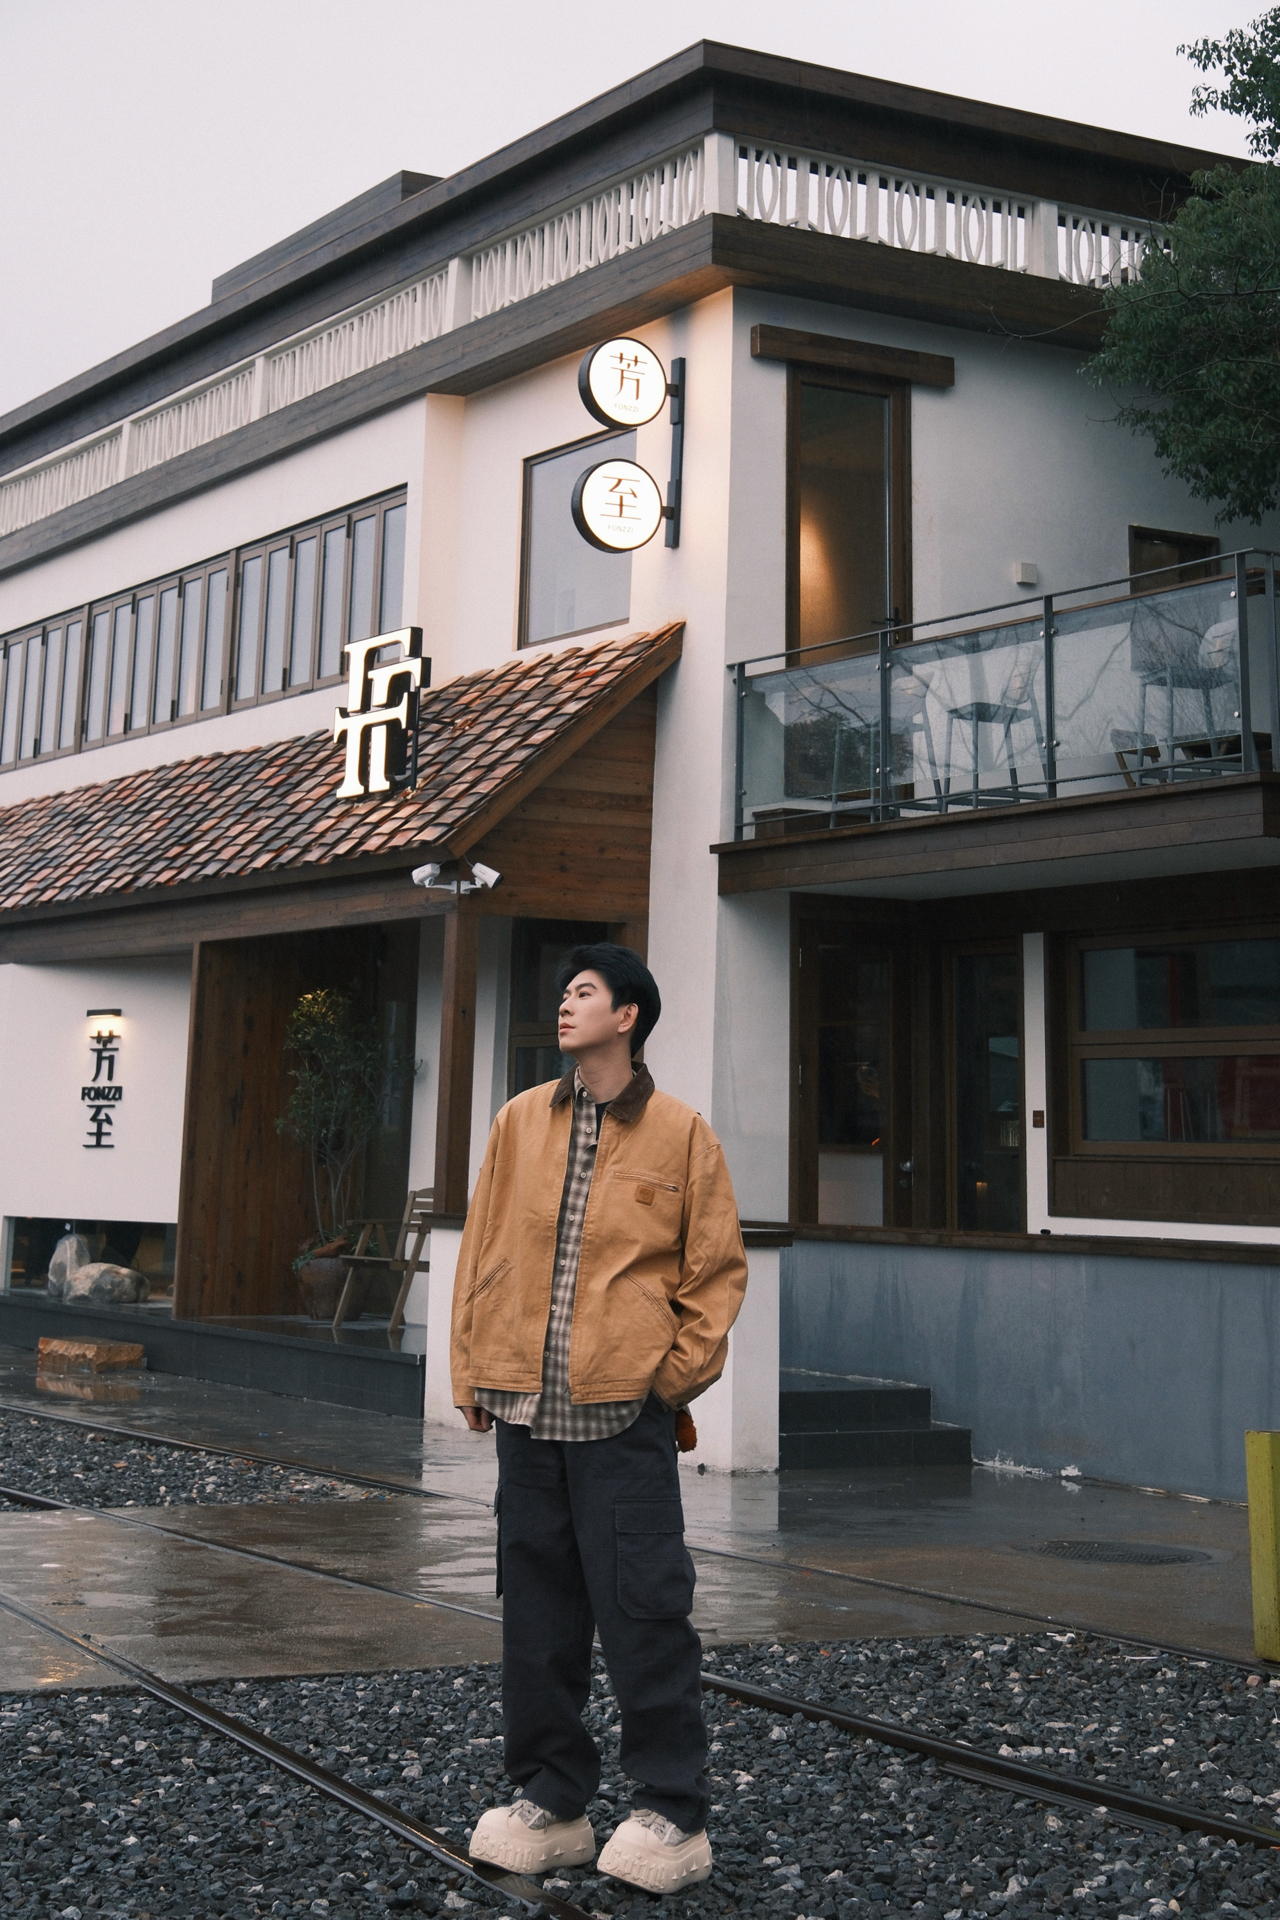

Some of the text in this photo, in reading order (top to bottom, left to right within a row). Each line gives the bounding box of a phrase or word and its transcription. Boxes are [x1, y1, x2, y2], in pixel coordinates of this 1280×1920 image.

[609, 352, 648, 401] 芳
[614, 402, 640, 413] FONZZI
[600, 475, 642, 520] 至
[607, 524, 634, 533] FONZZI
[89, 1029, 121, 1082] 芳
[81, 1086, 123, 1101] FONZZI
[82, 1104, 115, 1148] 至
